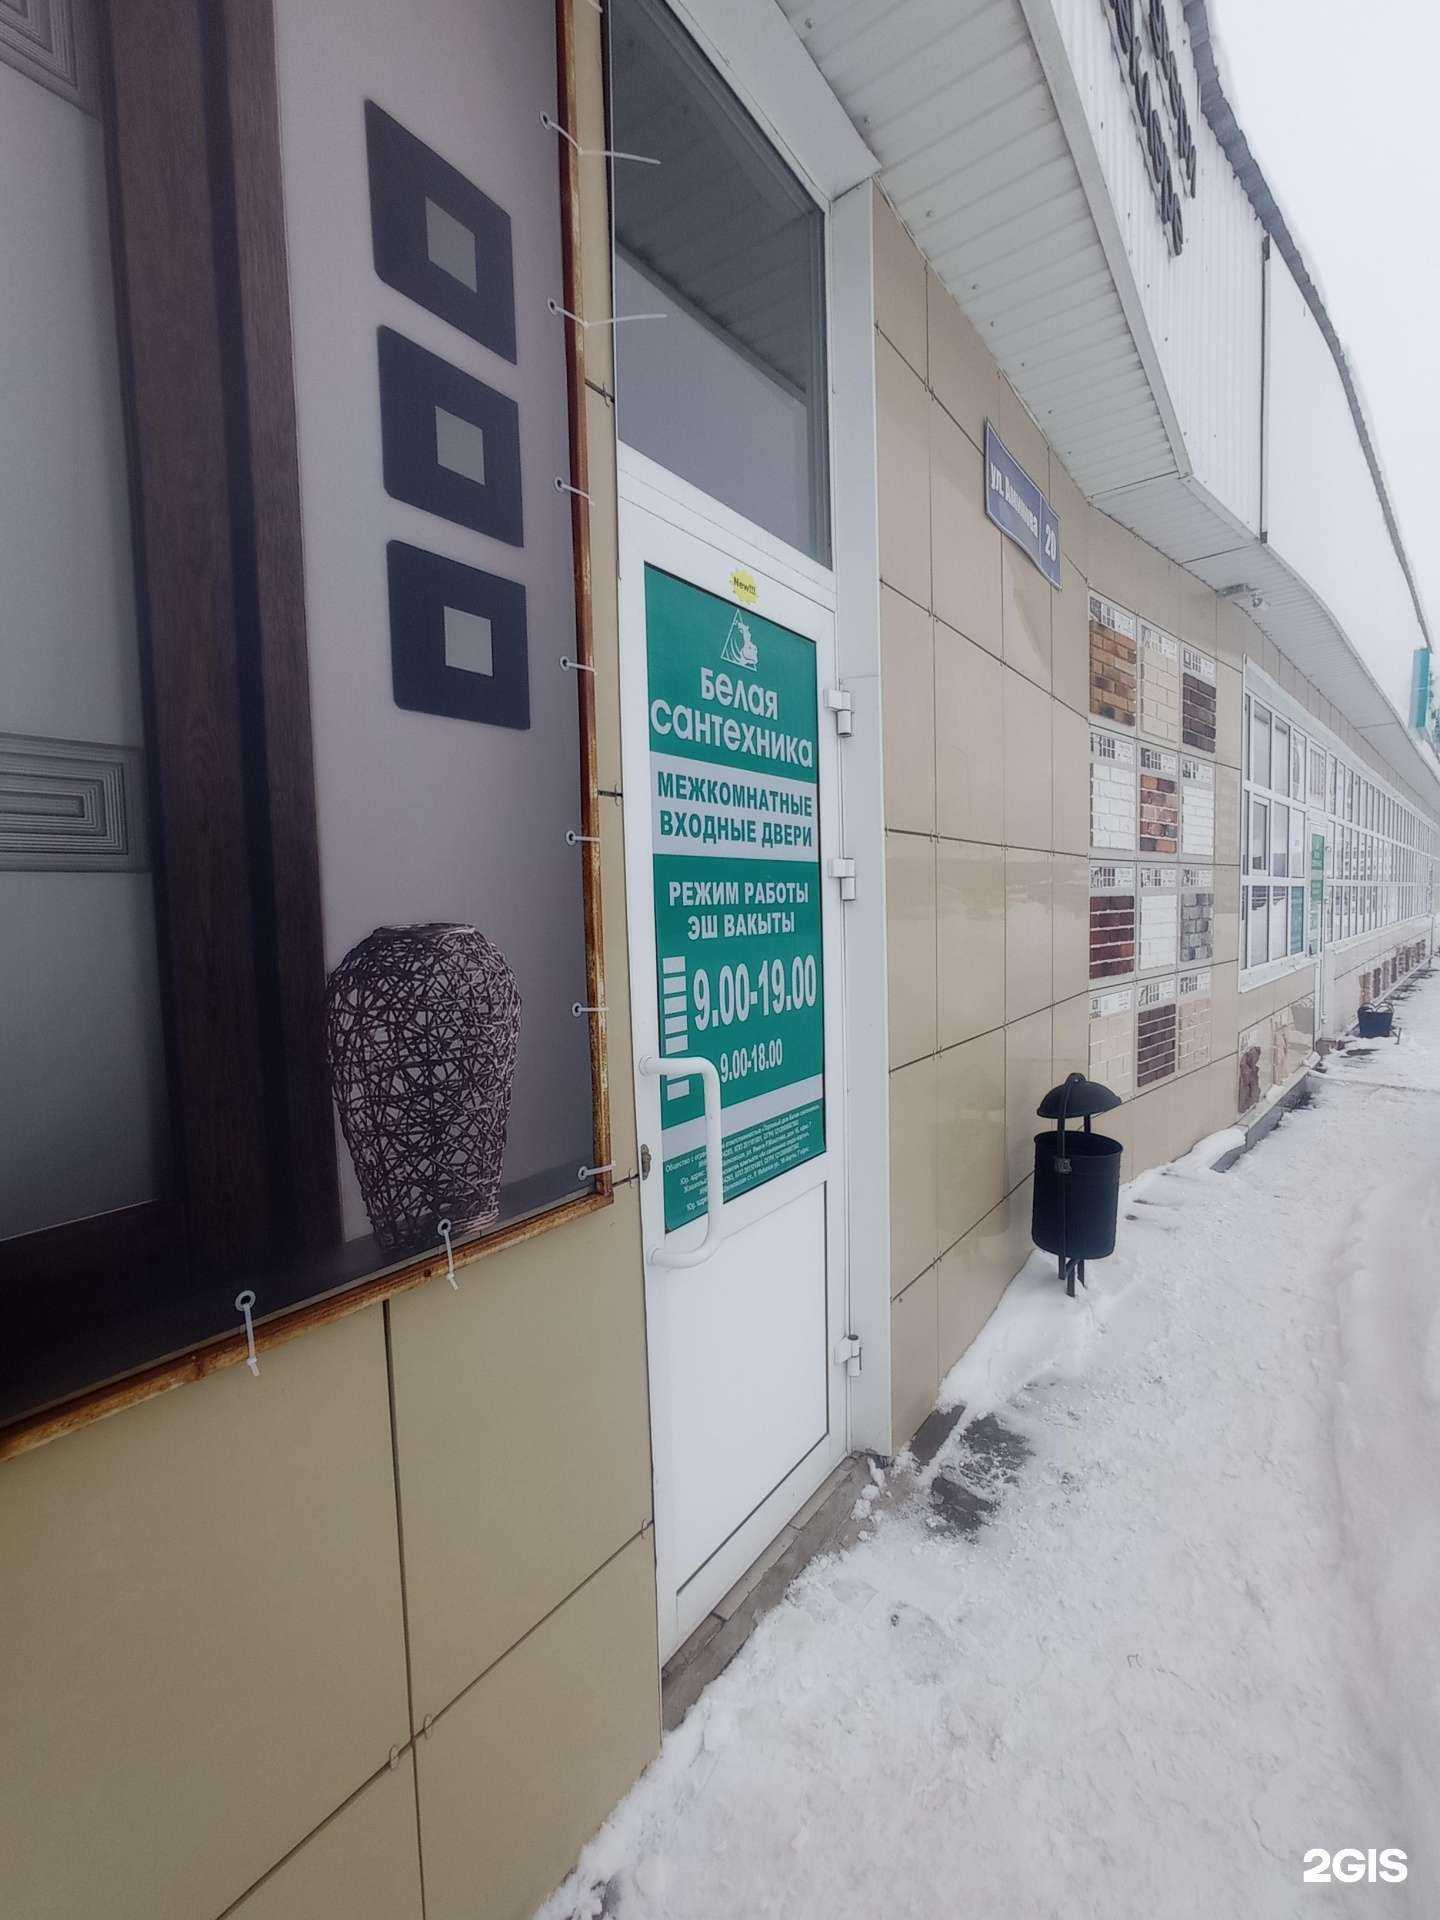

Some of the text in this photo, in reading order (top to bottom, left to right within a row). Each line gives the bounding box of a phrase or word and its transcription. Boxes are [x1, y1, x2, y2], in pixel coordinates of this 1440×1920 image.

[1045, 524, 1057, 562] 20
[701, 667, 779, 721] Белая
[651, 699, 814, 768] сантехника
[657, 770, 813, 818] МЕЖКОМНАТНЫЕ
[660, 810, 813, 849] ВХОДНЫЕ ДВЕРИ
[669, 881, 809, 907] РЕЖИМ РАБОТЫ
[687, 911, 795, 941] ЭШ ВАКЫТЫ
[693, 953, 817, 1032] 9.00-19.00
[720, 1038, 783, 1084] 9.00-18.00
